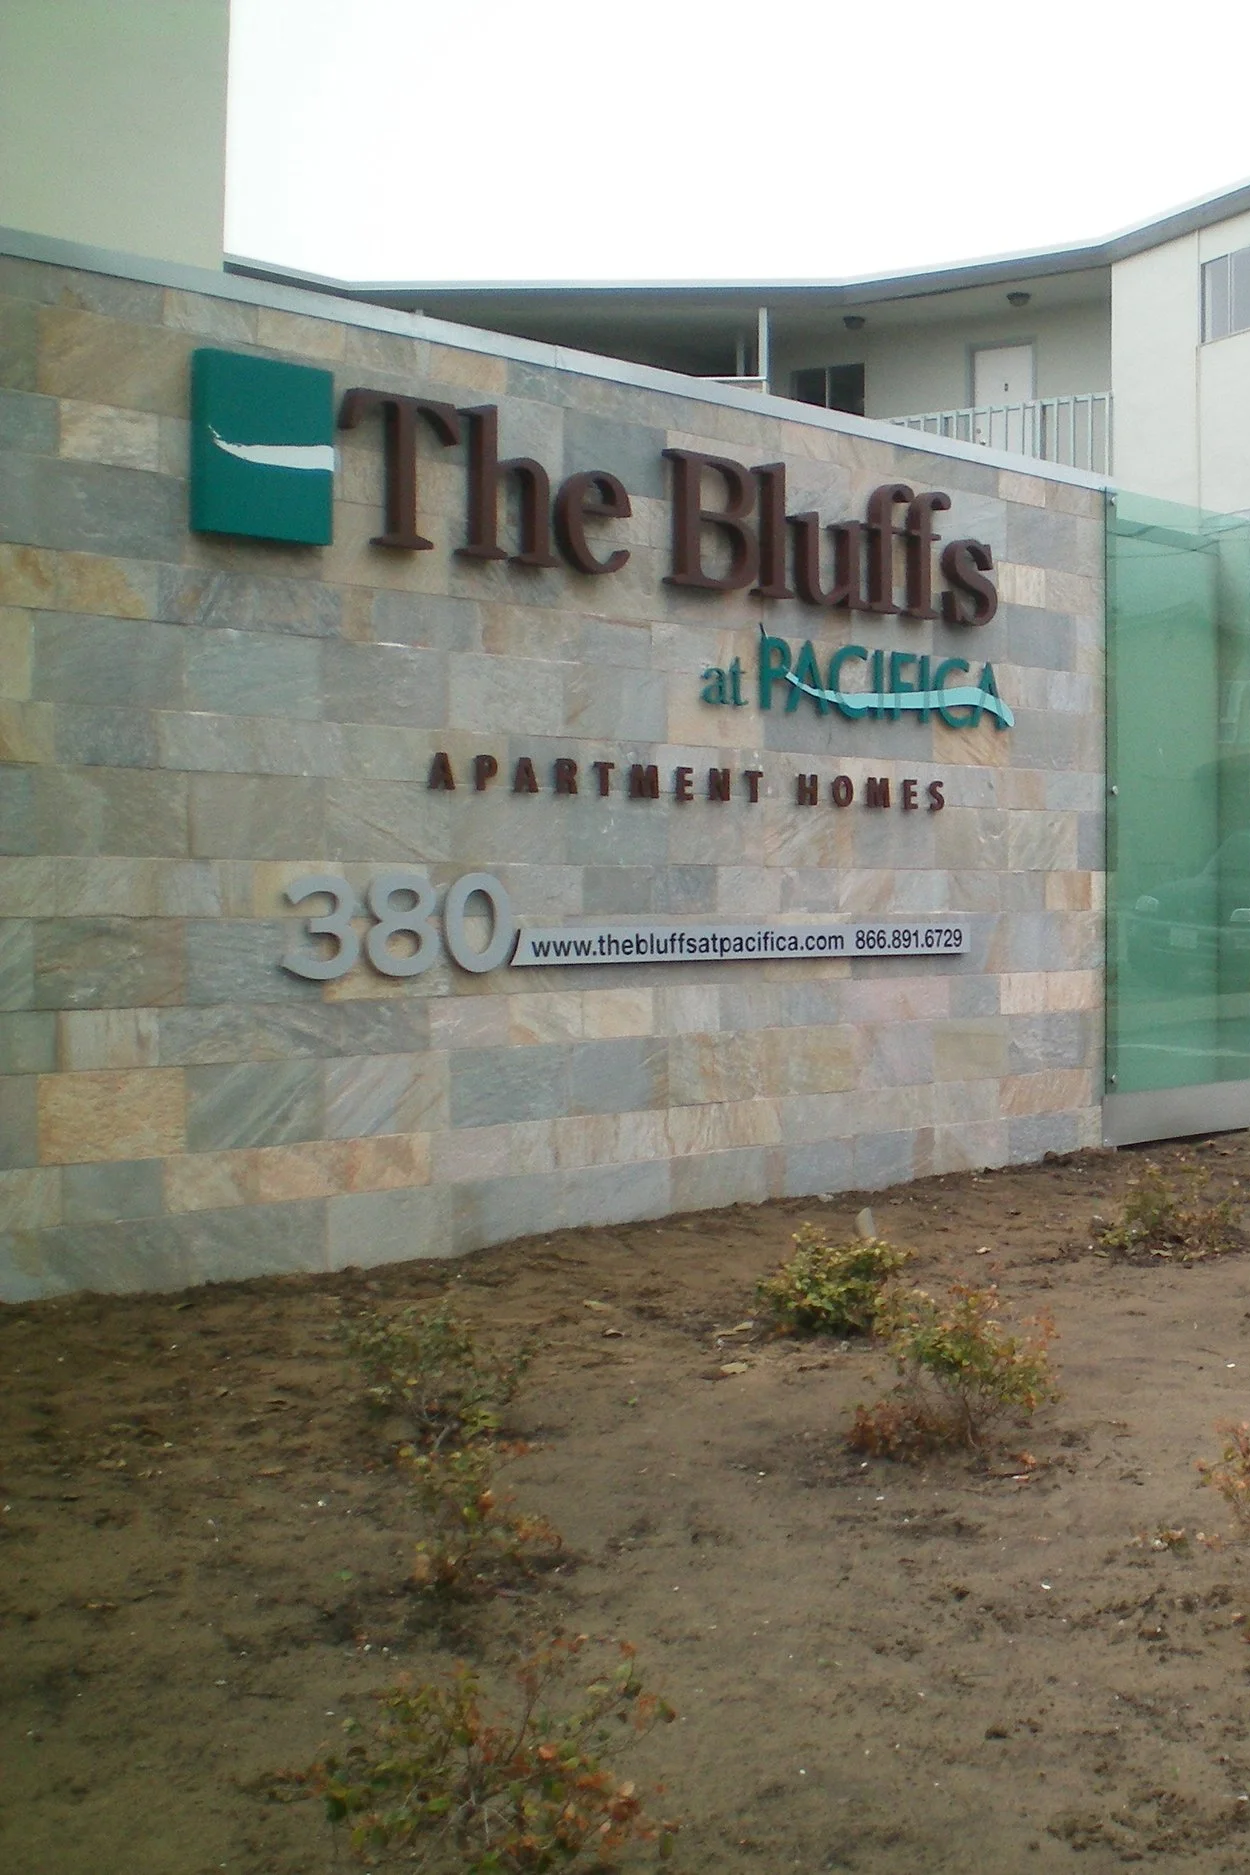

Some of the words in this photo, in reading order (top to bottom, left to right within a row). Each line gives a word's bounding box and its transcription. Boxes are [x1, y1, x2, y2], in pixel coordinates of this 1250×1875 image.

[338, 387, 632, 575] The
[661, 447, 1000, 627] Bluffs
[701, 655, 749, 707] at
[760, 630, 1012, 729] PACIFICA
[428, 752, 765, 804] APARTMENT
[797, 774, 946, 812] HOMES
[282, 873, 514, 981] 380
[530, 931, 845, 960] www.thebluffsatpacifica.com
[855, 928, 963, 949] 866.891.6729
